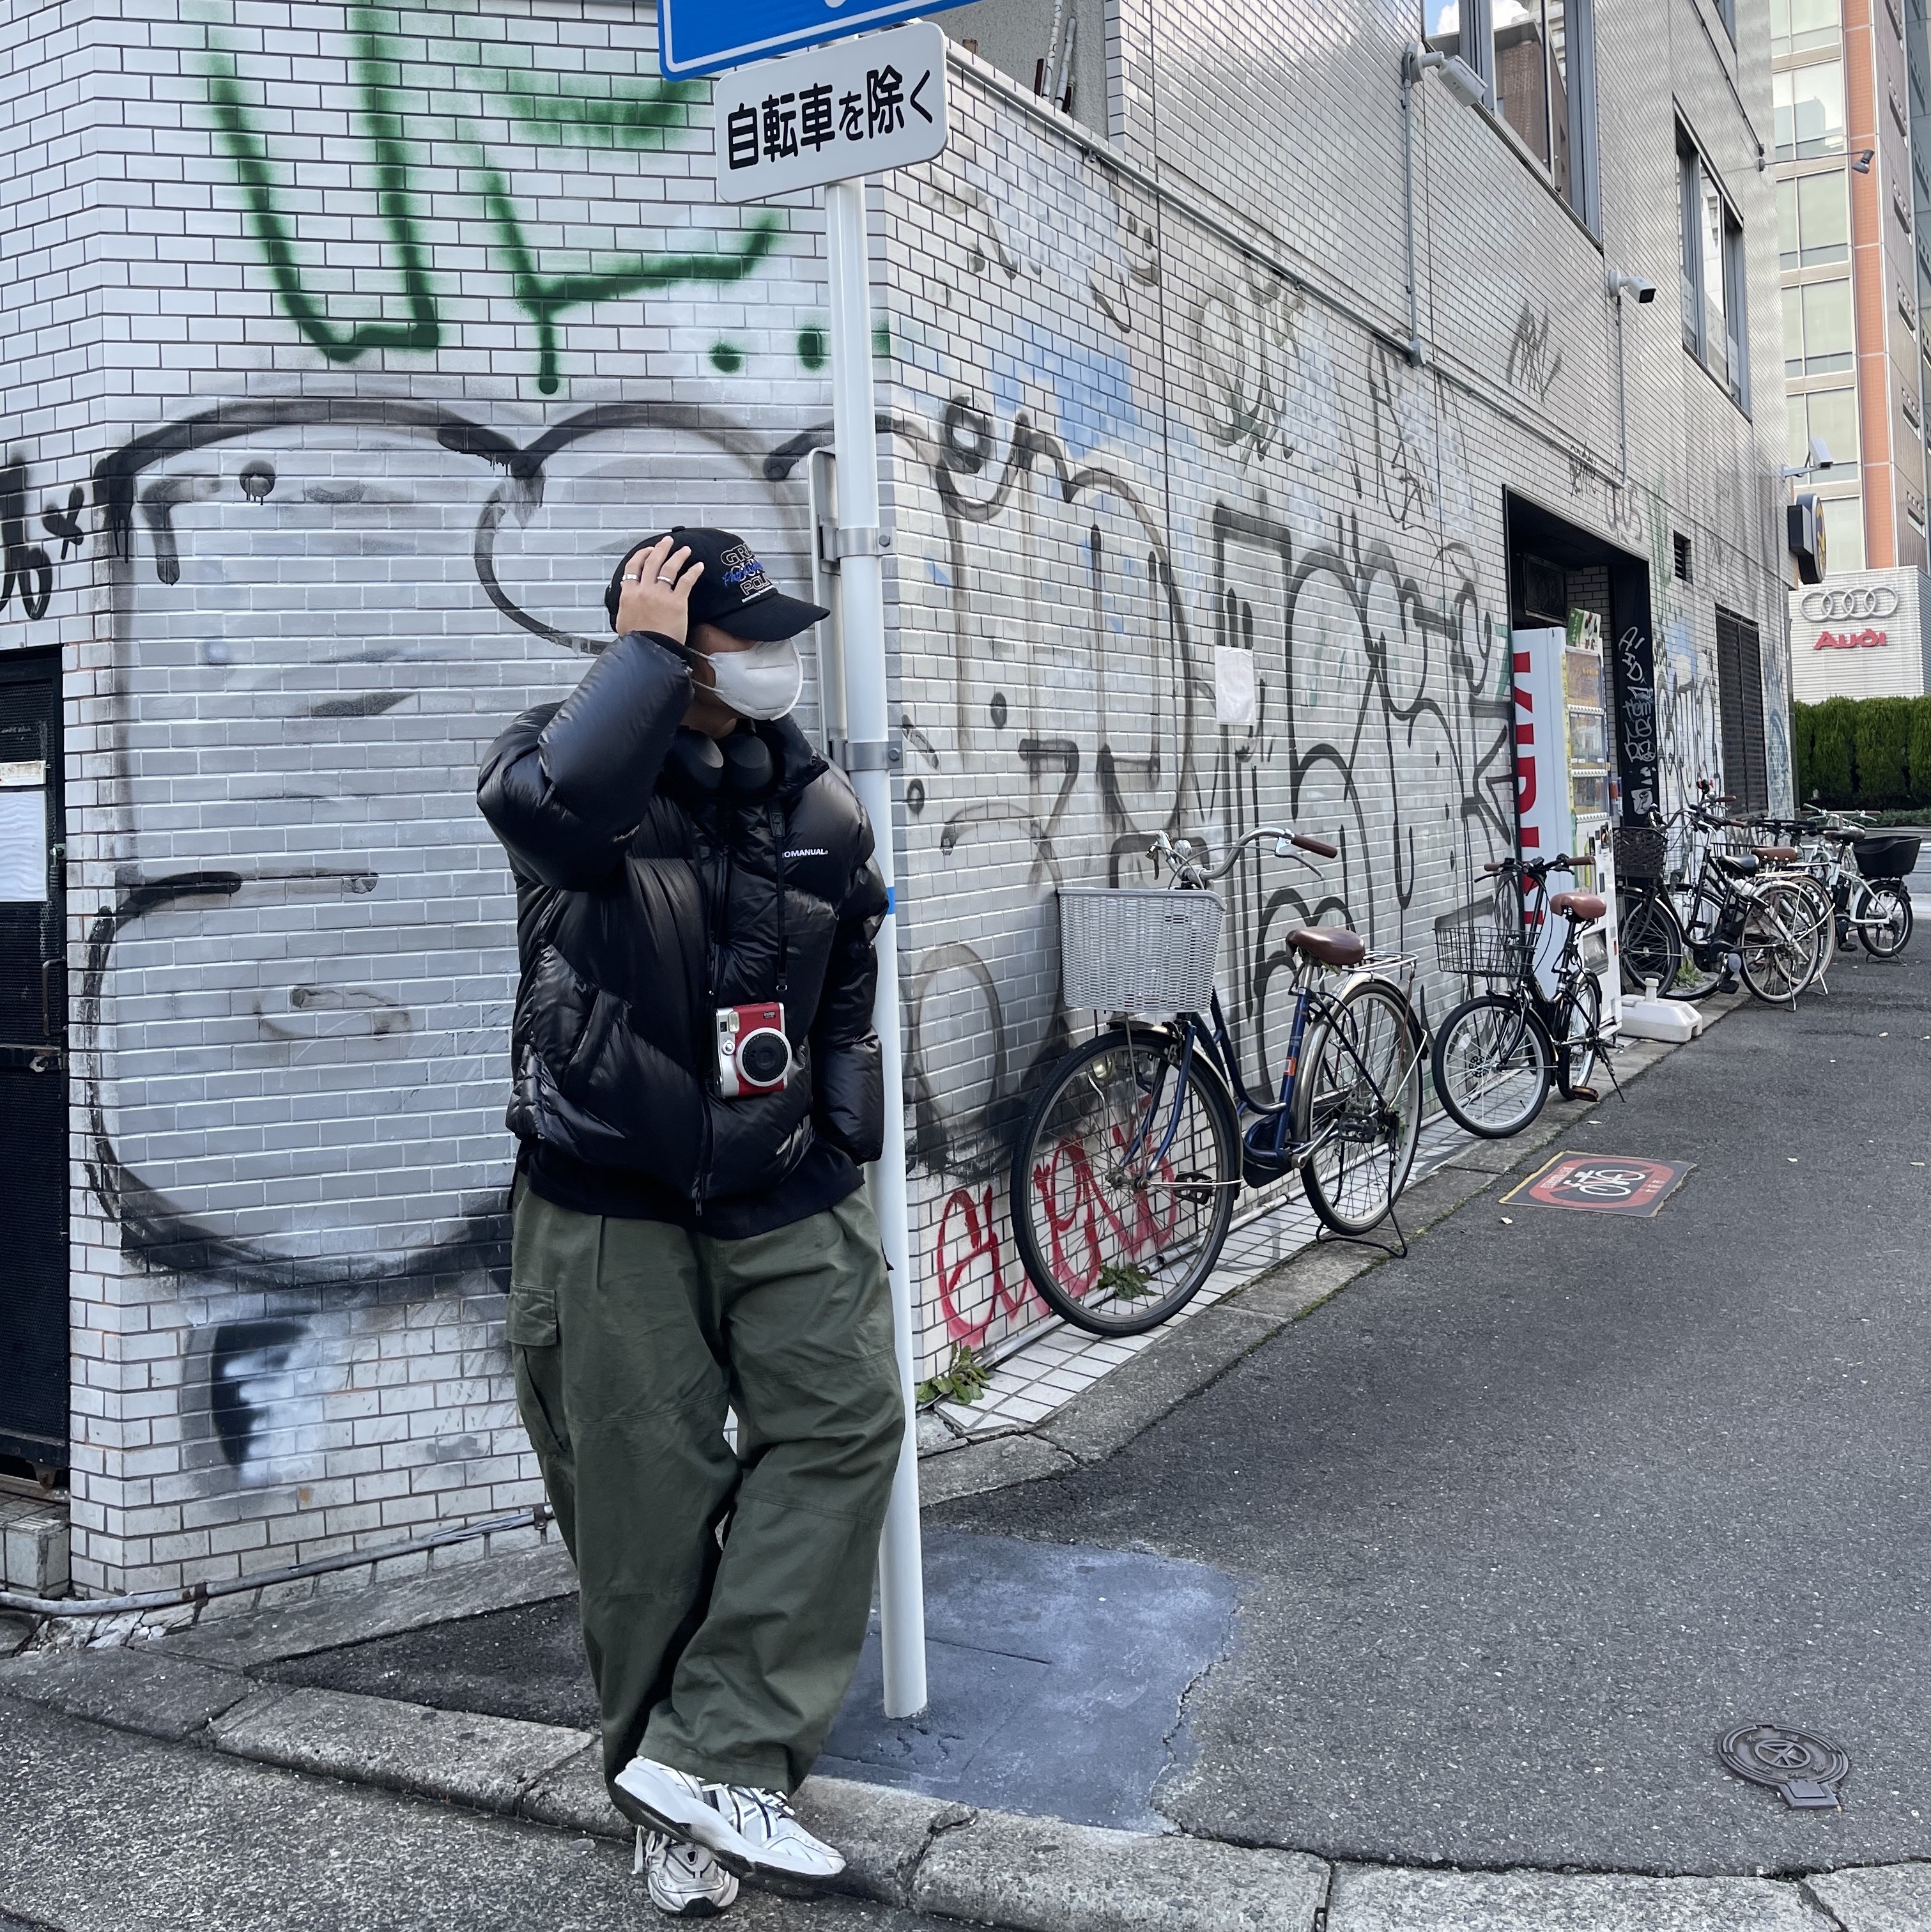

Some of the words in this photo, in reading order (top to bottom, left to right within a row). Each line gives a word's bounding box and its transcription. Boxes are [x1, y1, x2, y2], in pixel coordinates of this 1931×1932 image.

[727, 65, 933, 171] 自転車を除く
[1814, 628, 1887, 650] Audi
[781, 848, 826, 858] OMANUAL
